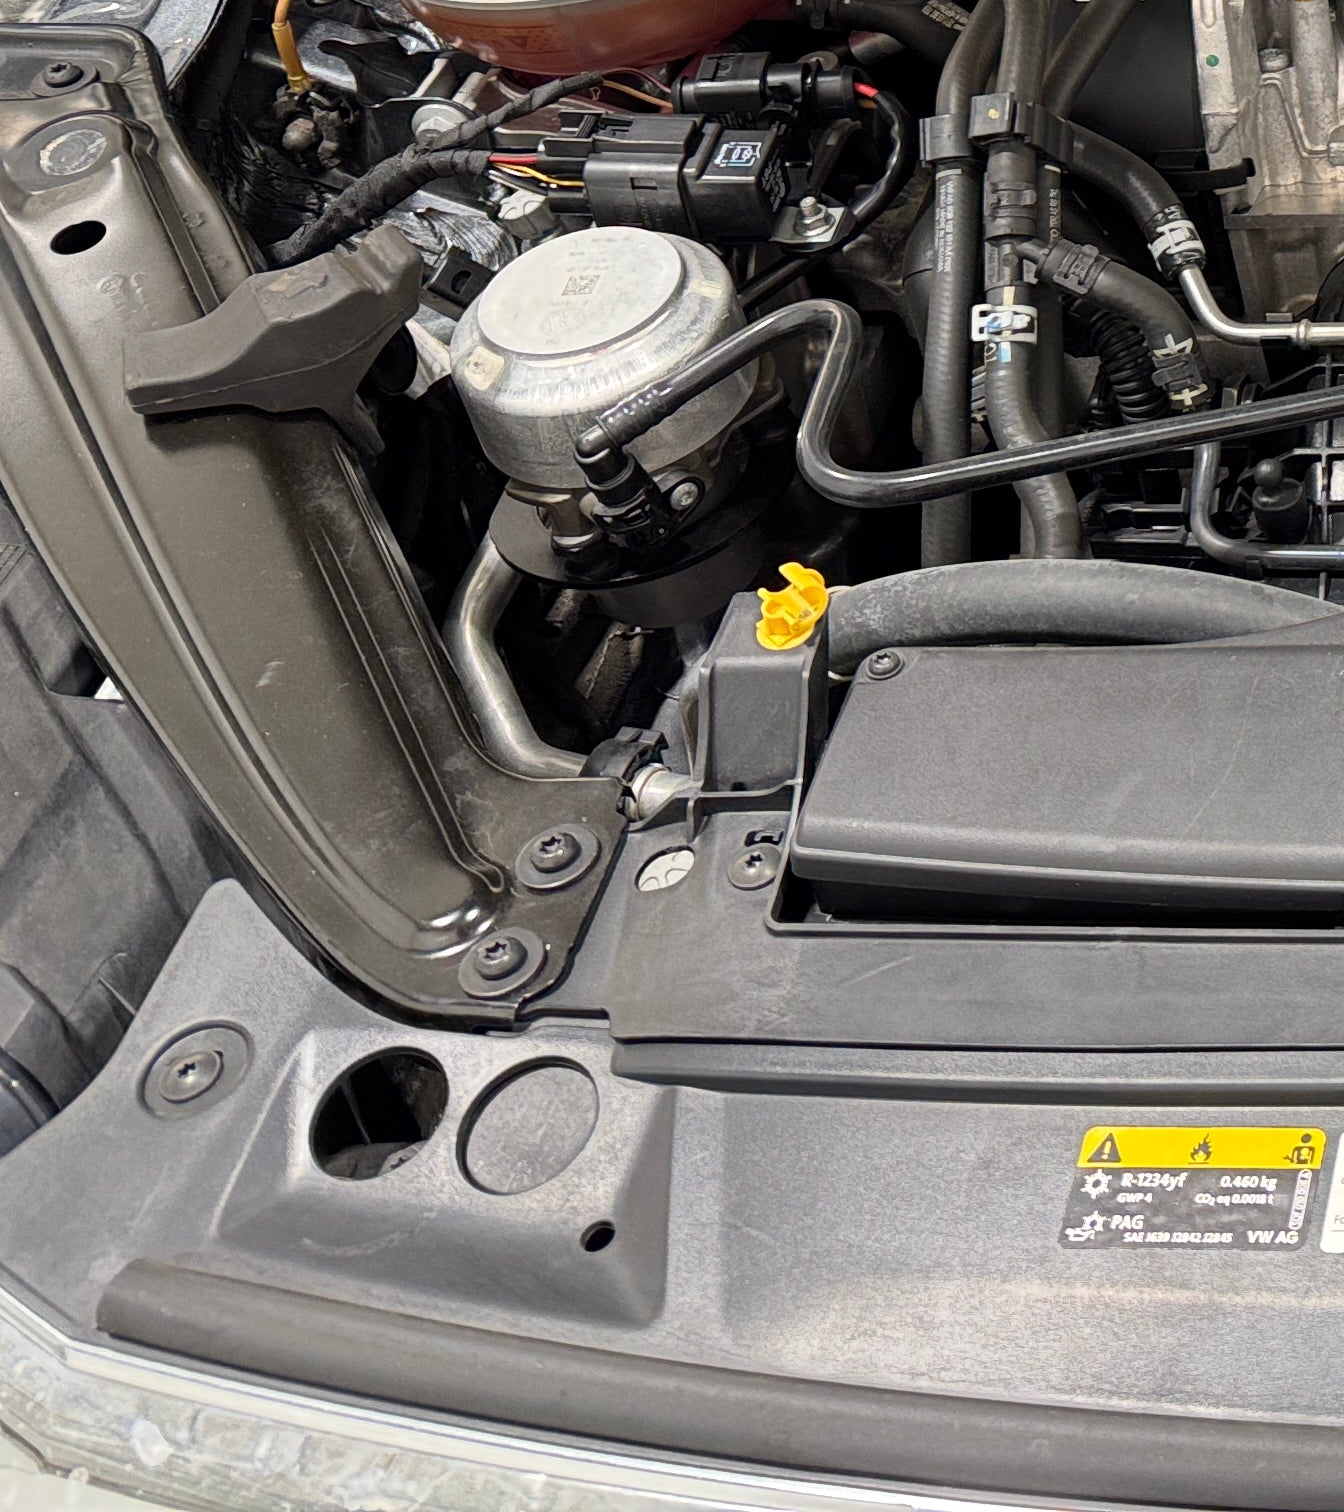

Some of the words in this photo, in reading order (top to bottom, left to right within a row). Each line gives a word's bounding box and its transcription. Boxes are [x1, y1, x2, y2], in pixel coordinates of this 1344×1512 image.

[1120, 1172, 1188, 1191] R-1234yf
[1220, 1175, 1259, 1188] 0.460
[1260, 1175, 1278, 1192] kg
[1117, 1192, 1144, 1203] GWP
[1110, 1214, 1144, 1229] PAG
[1122, 1232, 1144, 1242] SAE
[1246, 1230, 1274, 1244] VW
[1274, 1230, 1299, 1245] AG
